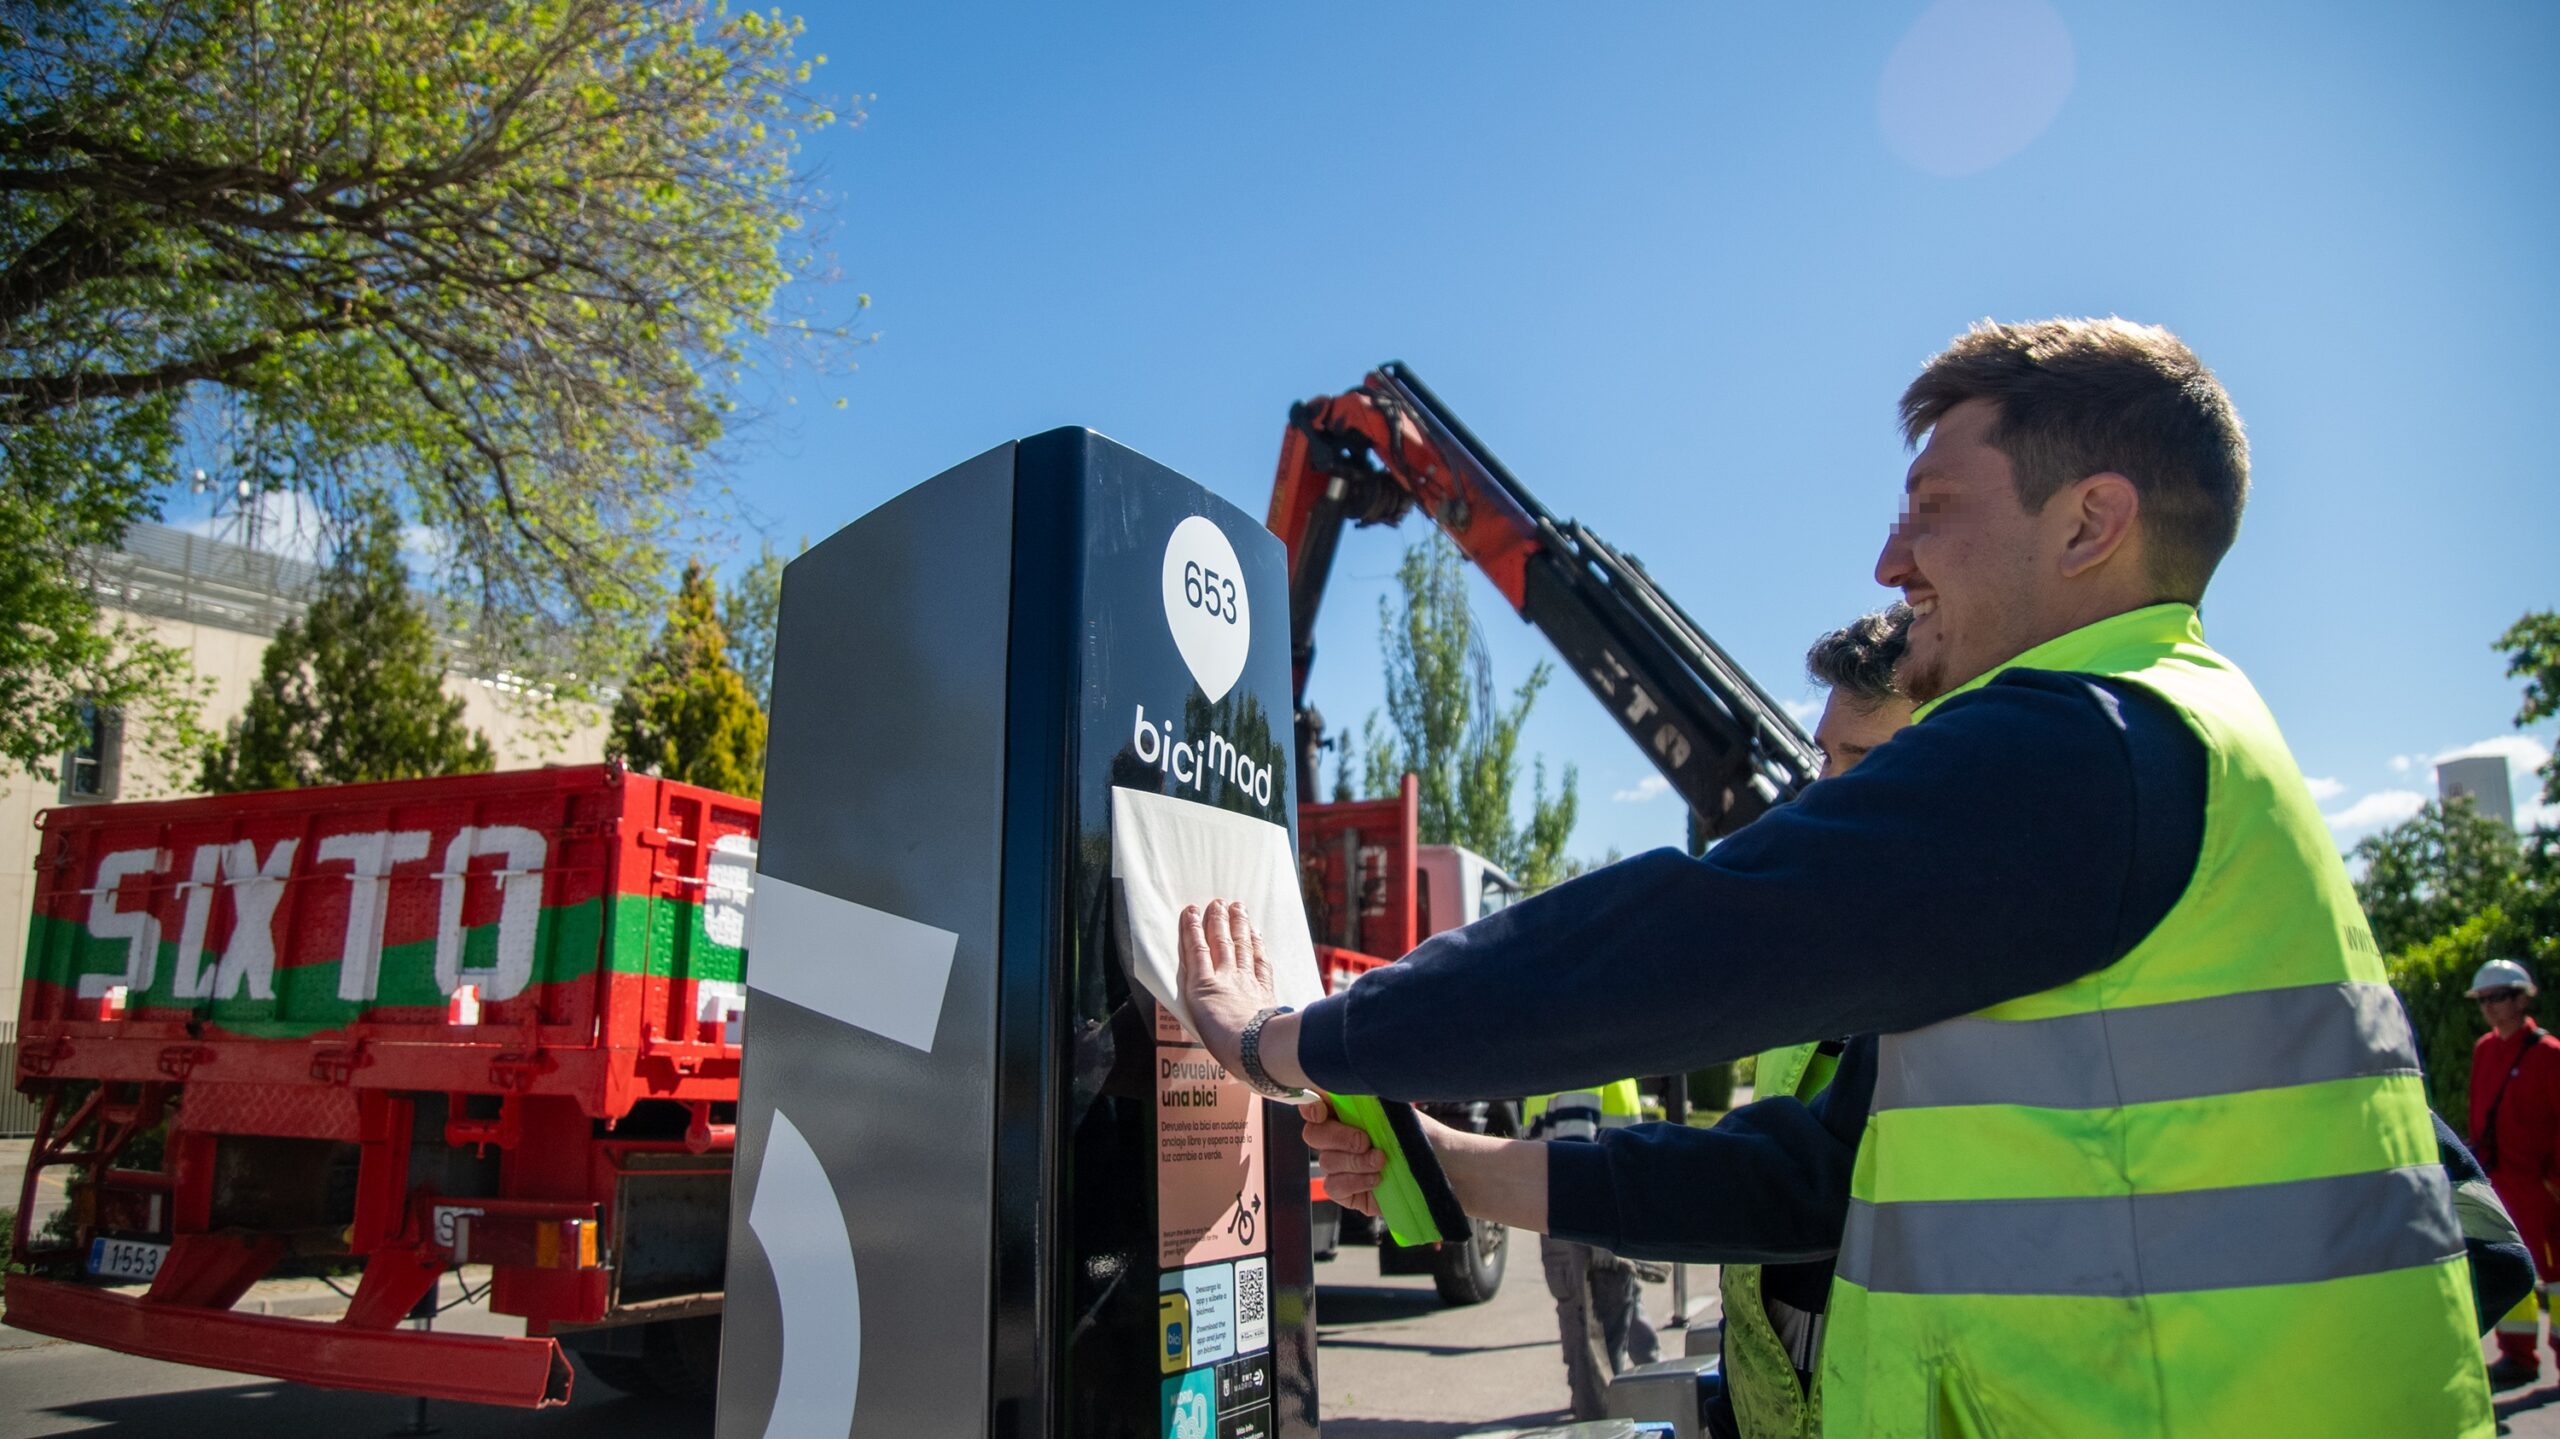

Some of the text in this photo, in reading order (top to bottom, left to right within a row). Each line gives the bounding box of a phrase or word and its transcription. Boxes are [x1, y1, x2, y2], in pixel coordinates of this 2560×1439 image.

[1184, 561, 1237, 625] 653
[1134, 704, 1272, 807] bicimad
[79, 826, 548, 1001] SIXTO
[1161, 1058, 1226, 1080] Devuelve
[1161, 1084, 1218, 1107] una bici
[1161, 1119, 1248, 1132] Devuelve la bici en cualquier
[1162, 1136, 1186, 1149] anclaje
[1187, 1136, 1200, 1146] libre
[1202, 1139, 1207, 1148] y
[1208, 1137, 1228, 1148] espera
[1235, 1136, 1246, 1147] que
[1162, 1152, 1172, 1162] luz
[1204, 1151, 1223, 1160] verde.
[111, 1244, 158, 1275] 1553
